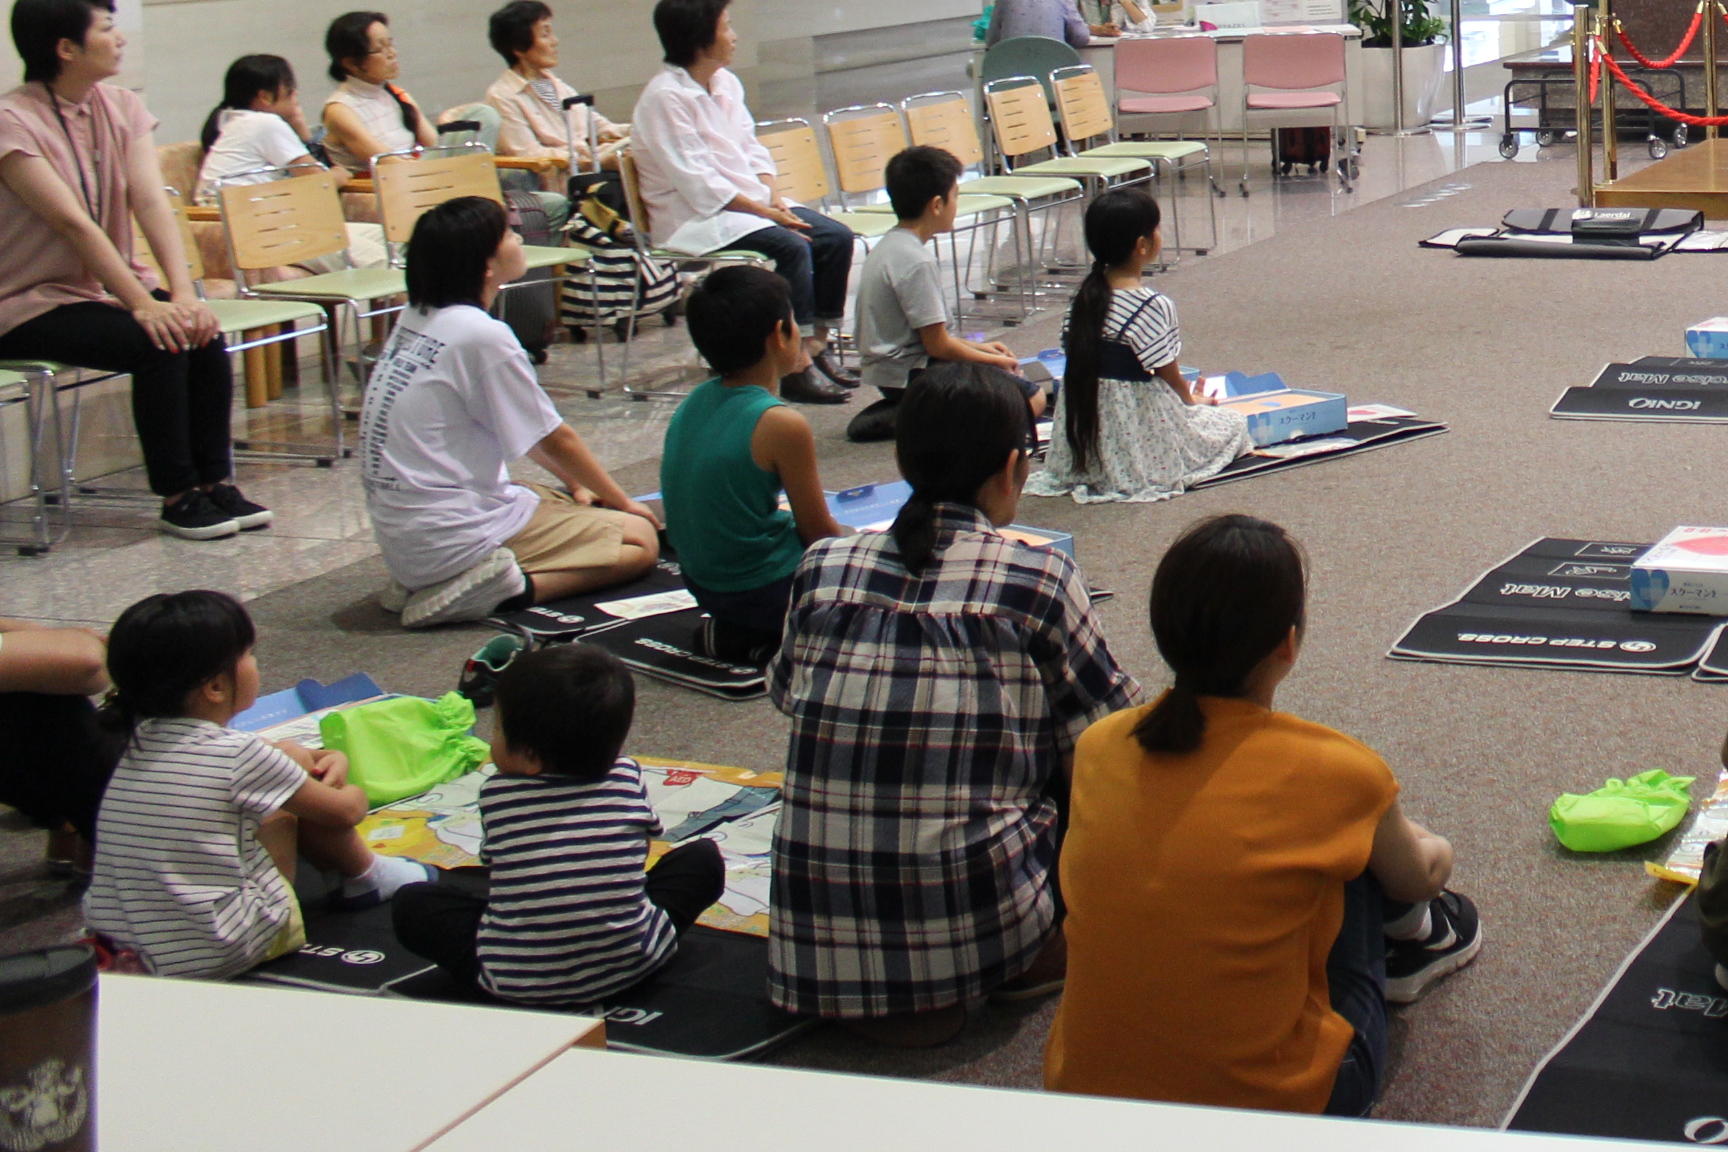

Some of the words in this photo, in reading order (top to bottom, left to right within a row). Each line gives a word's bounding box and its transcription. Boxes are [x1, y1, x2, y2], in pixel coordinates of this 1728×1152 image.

[1594, 211, 1631, 219] Laerdal
[1618, 372, 1670, 384] Mat
[1628, 397, 1702, 410] IGNIO
[1500, 582, 1572, 599] Mat
[1549, 639, 1613, 650] STEP
